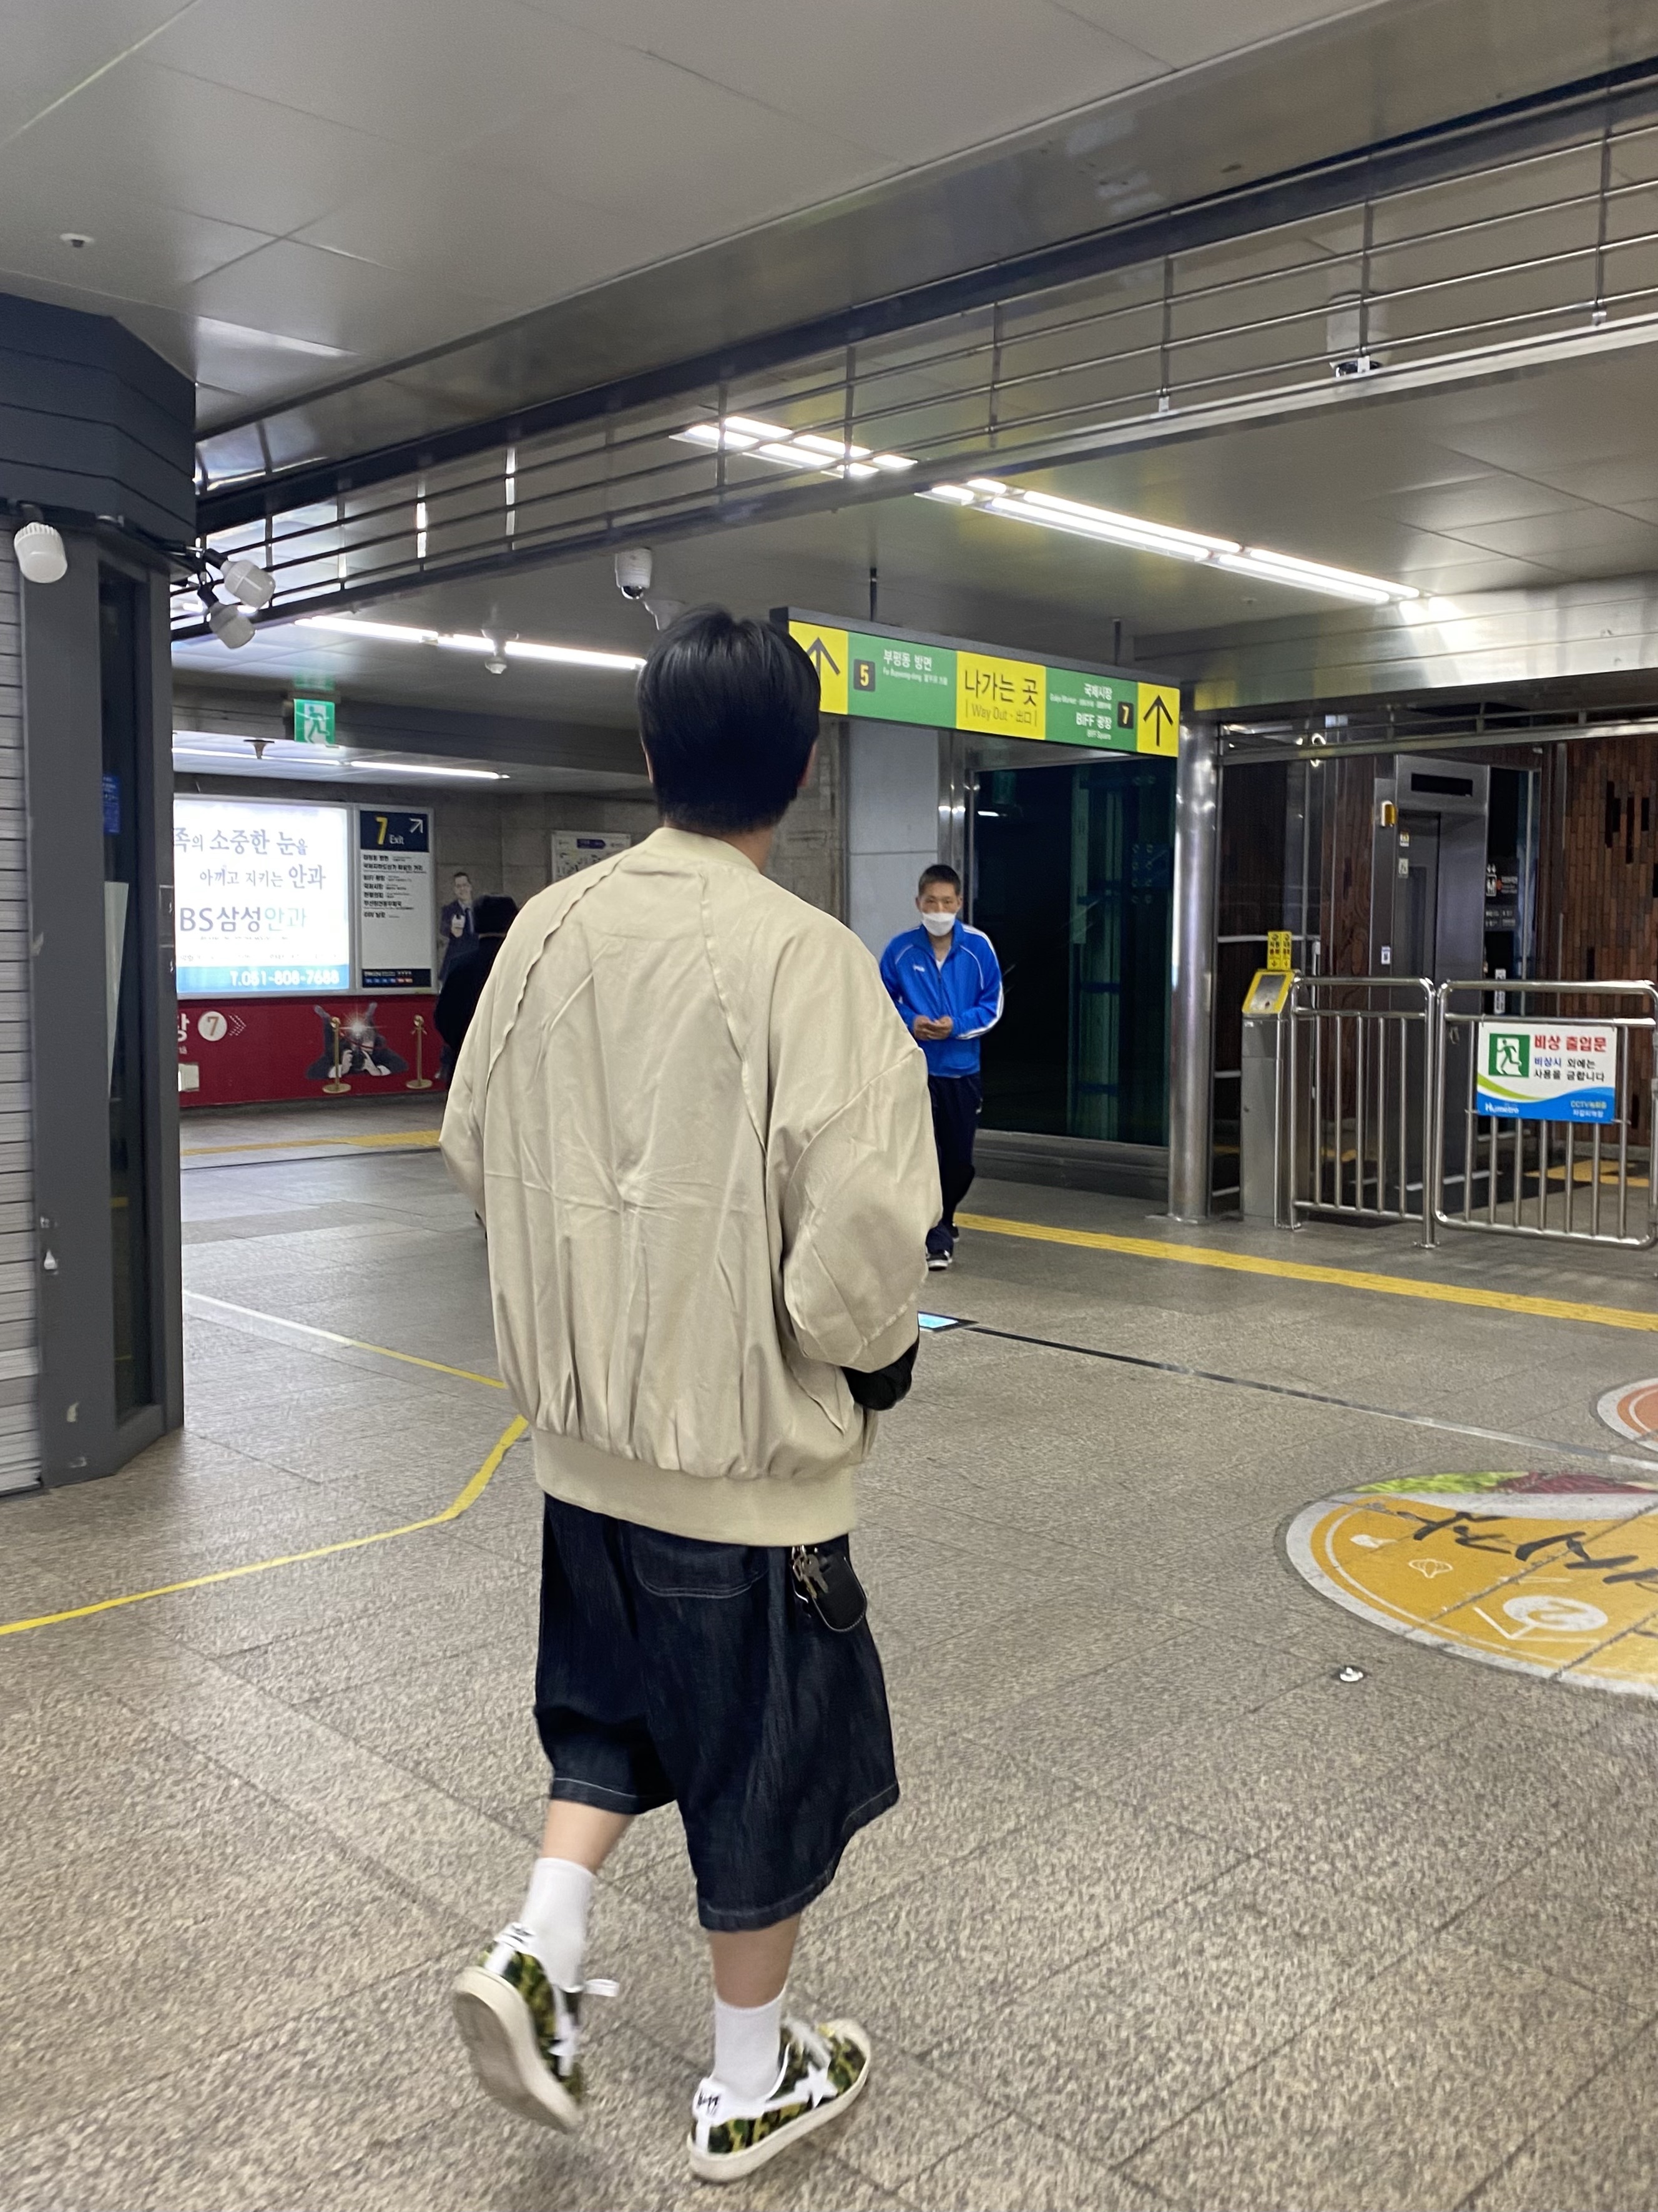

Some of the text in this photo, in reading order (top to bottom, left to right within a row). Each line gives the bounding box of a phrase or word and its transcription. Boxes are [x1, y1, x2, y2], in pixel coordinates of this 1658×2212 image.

[883, 649, 932, 672] 부평동 방면
[860, 664, 870, 686] 5
[964, 669, 1038, 707] 나가는 곳
[1084, 682, 1113, 700] 국제시장
[971, 704, 1032, 724] Way Out 出口
[1076, 712, 1095, 727] BIFF
[1121, 704, 1129, 724] 7
[375, 816, 405, 845] 7 Exit
[210, 828, 270, 855] 소중한
[277, 831, 308, 855] 눈을
[200, 864, 326, 890] 아끼고 지키는 안과
[207, 1016, 219, 1036] 7
[1534, 1034, 1607, 1053] 비상 출입문
[1534, 1056, 1596, 1069] 비상시 외에는
[1534, 1069, 1605, 1082] 사용을 금합니다
